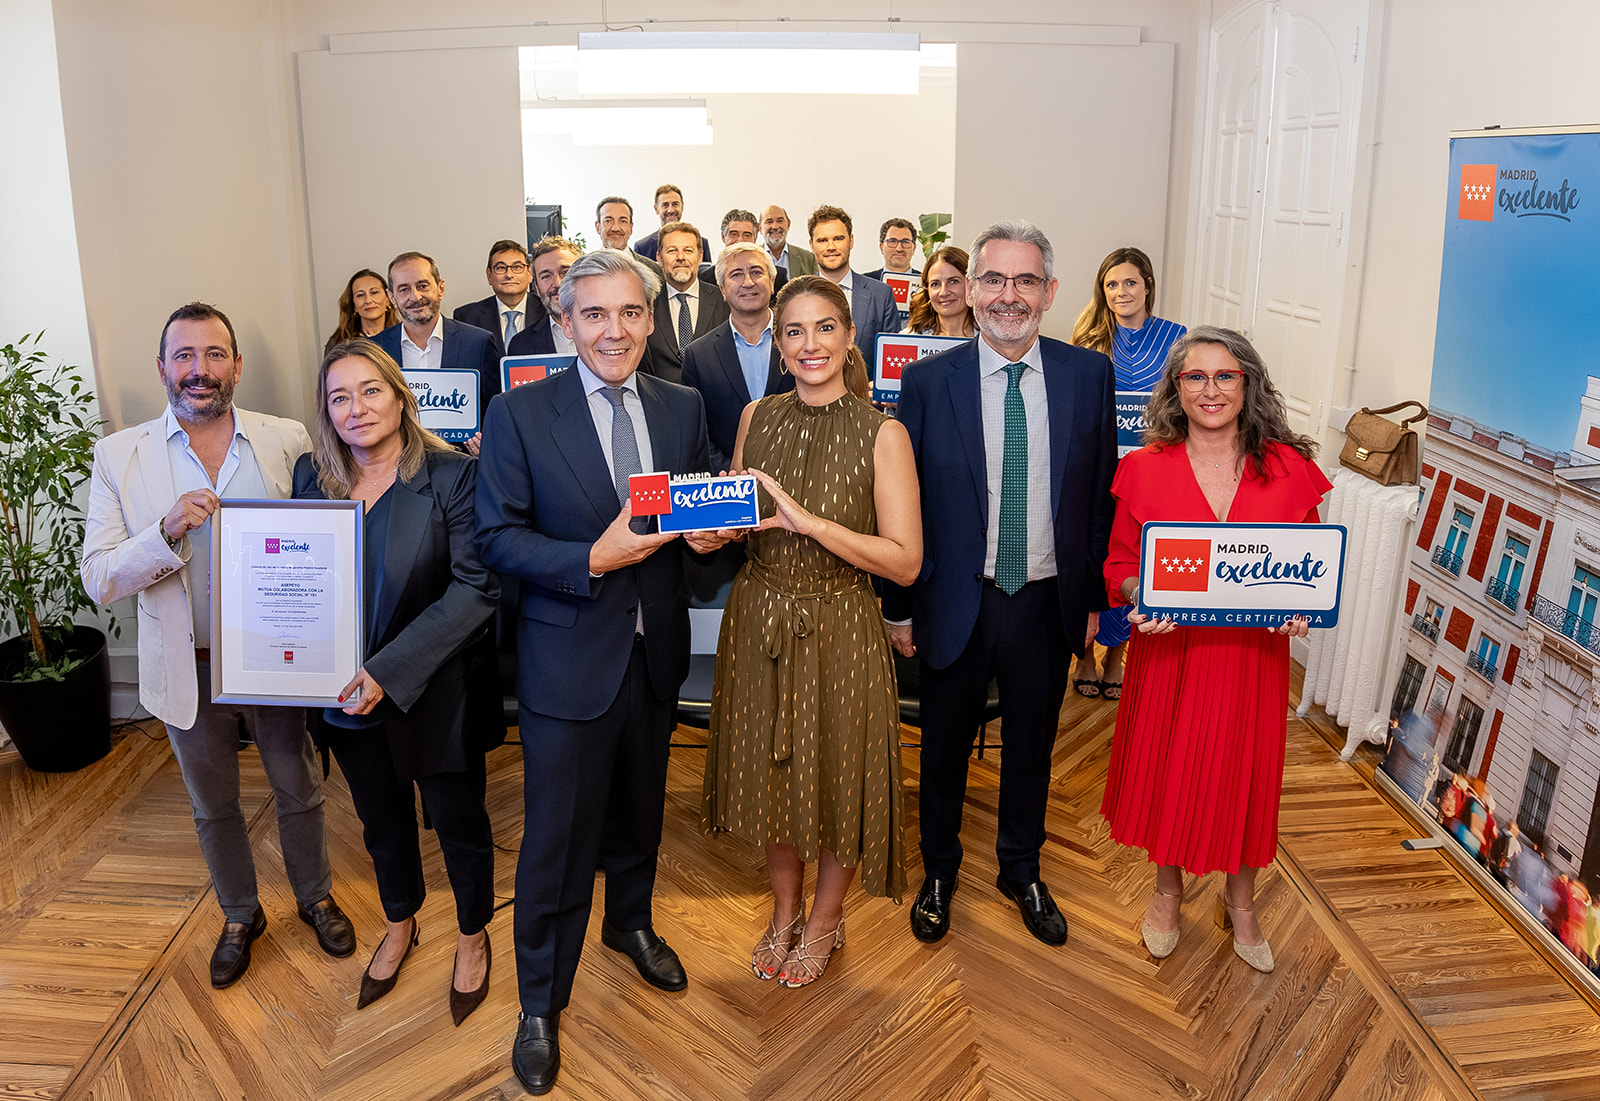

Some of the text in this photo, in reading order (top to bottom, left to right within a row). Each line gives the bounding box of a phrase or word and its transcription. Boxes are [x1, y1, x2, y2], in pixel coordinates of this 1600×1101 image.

[1500, 169, 1537, 181] MADRID
[1498, 178, 1580, 214] excelente
[1116, 404, 1148, 412] MADRID
[673, 471, 712, 483] MADRID
[673, 479, 755, 509] excelente
[1217, 543, 1270, 554] MADRID
[1215, 552, 1328, 584] excelente
[1152, 611, 1324, 624] EMPRESA CERTIFICDA
